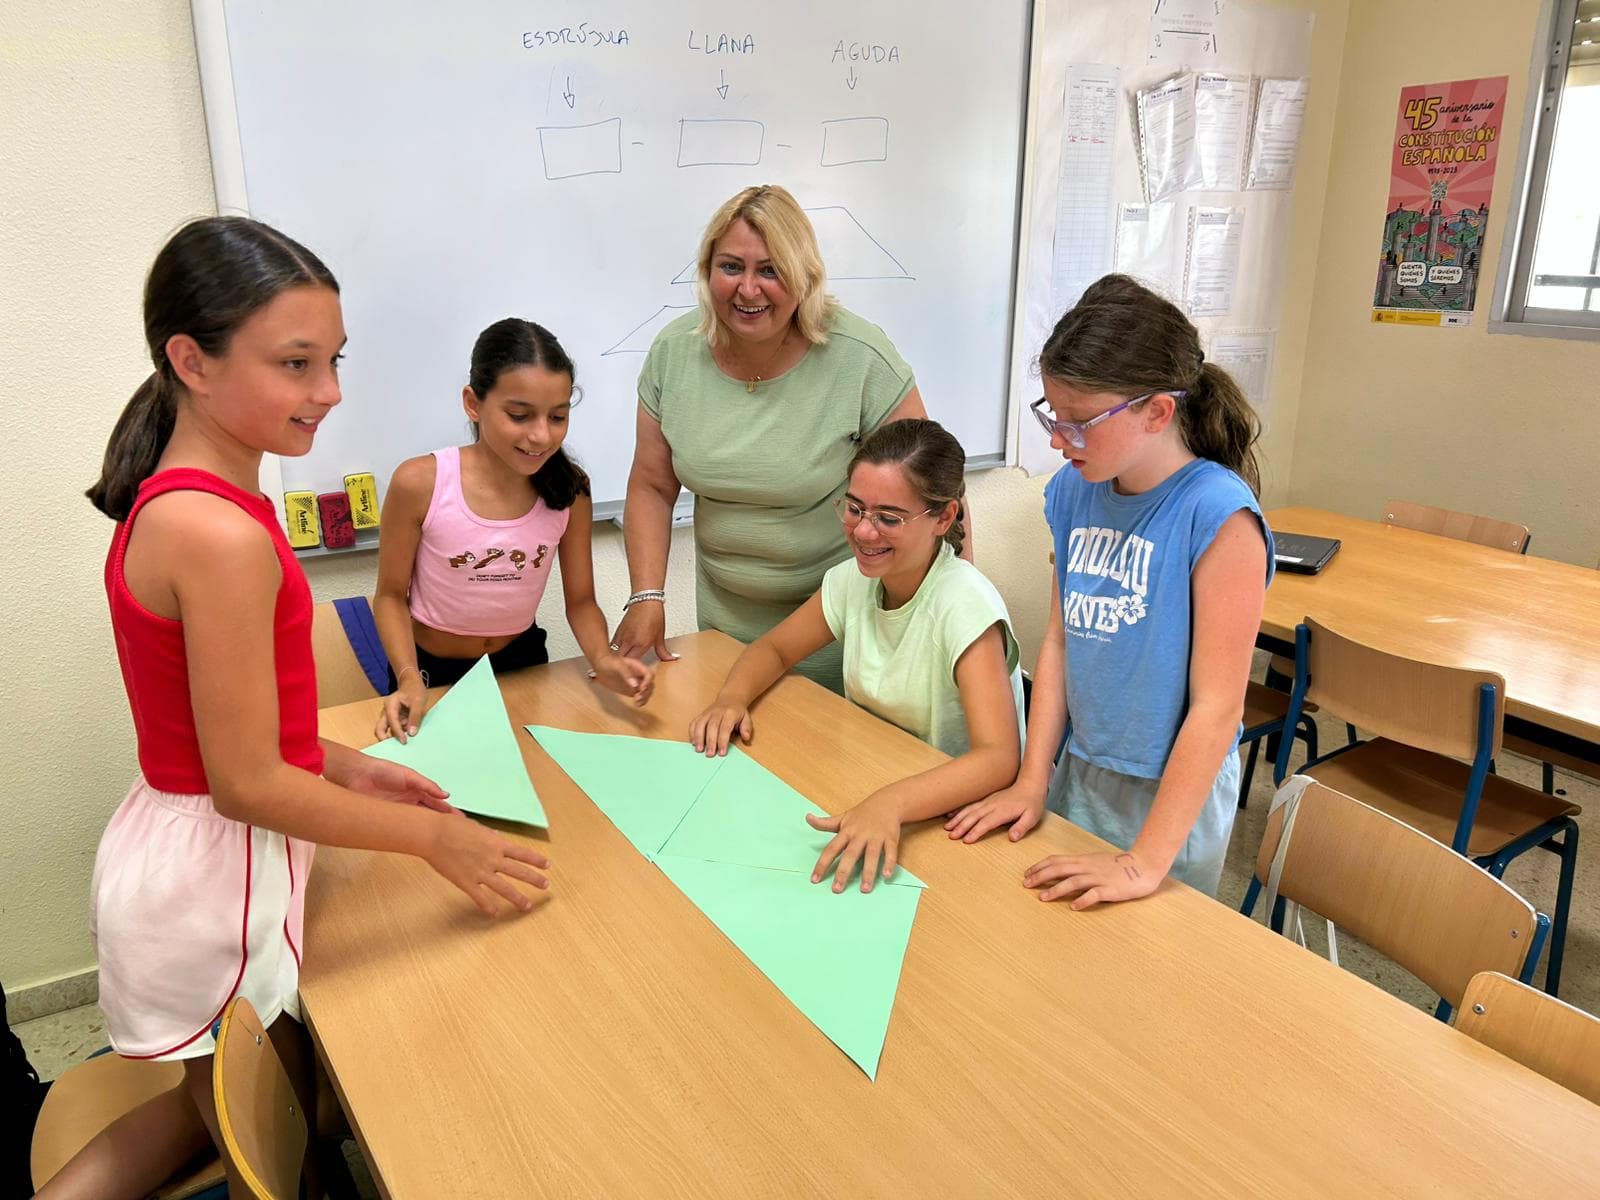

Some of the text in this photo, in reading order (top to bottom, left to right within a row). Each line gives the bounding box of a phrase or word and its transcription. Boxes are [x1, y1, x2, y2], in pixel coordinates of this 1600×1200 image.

[522, 22, 902, 64] ESDRÚJULA LLANA AGUDA
[1404, 96, 1443, 131] 45
[1401, 143, 1487, 166] ESPAÑOLA
[299, 510, 310, 535] Artline
